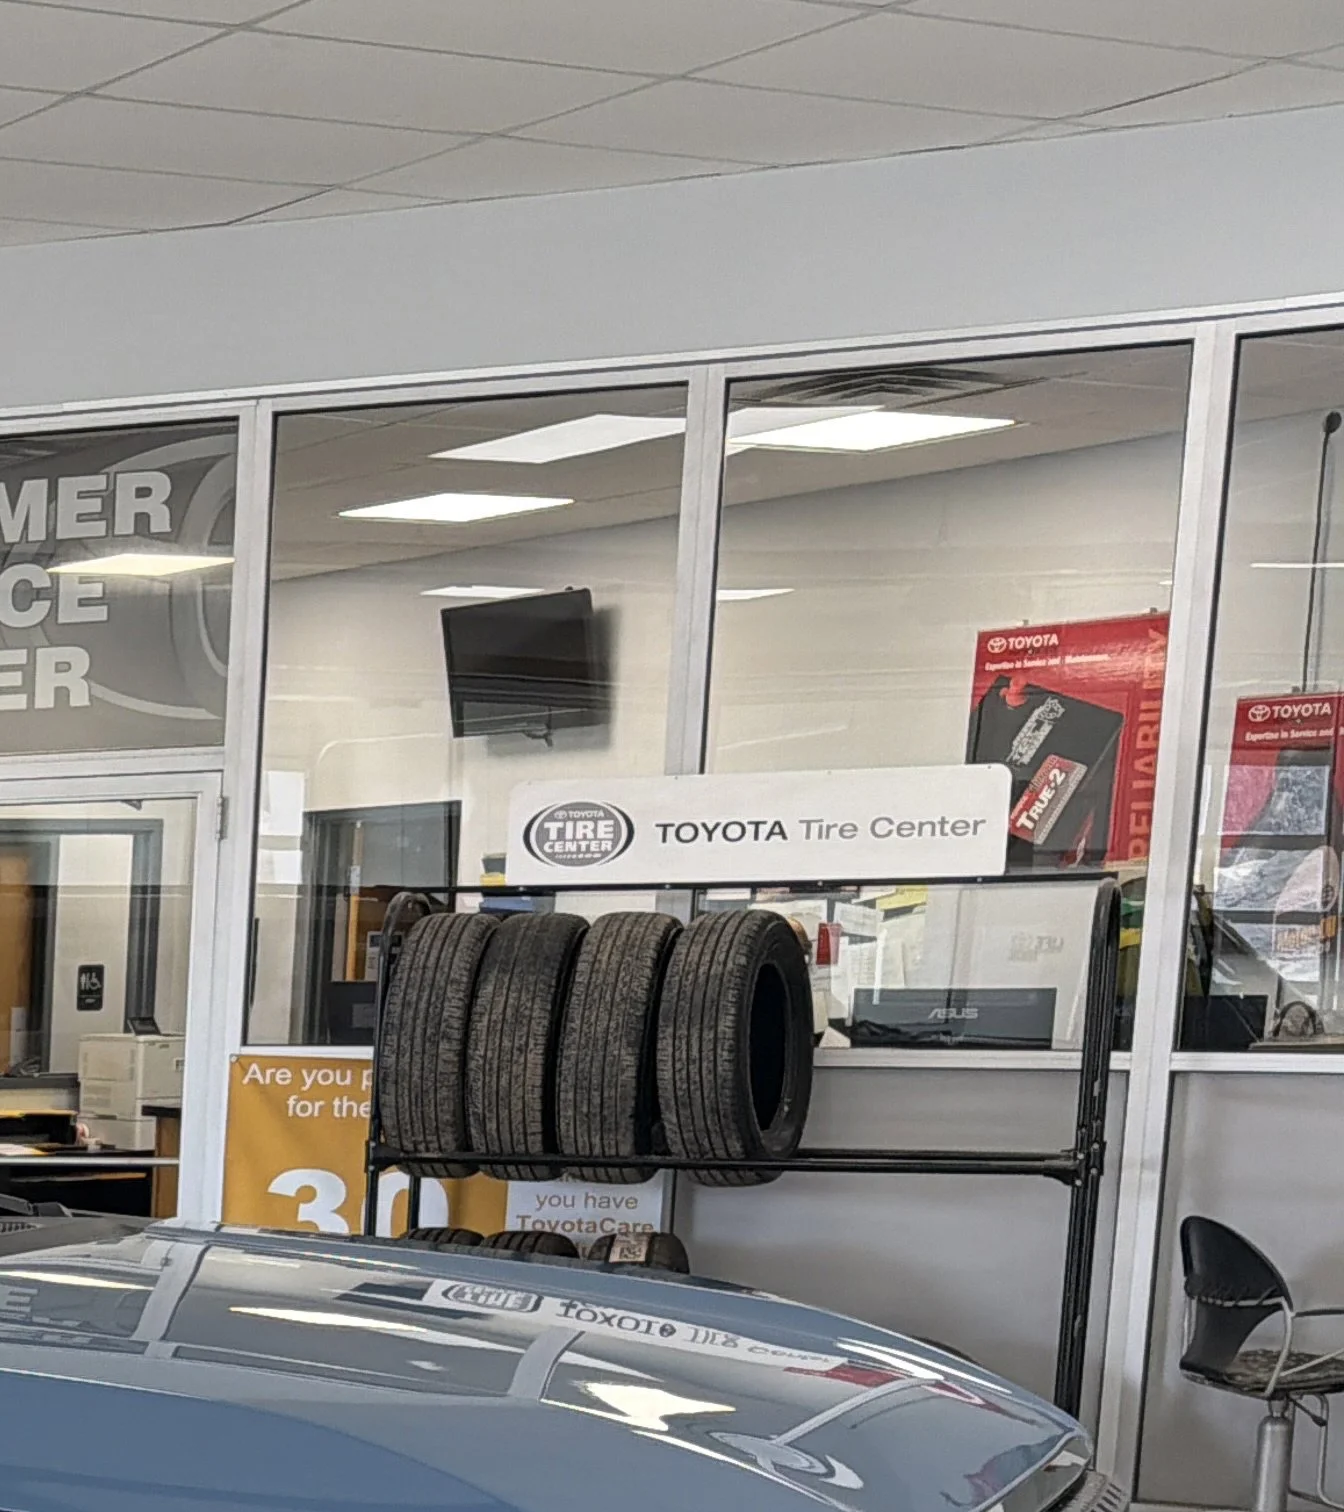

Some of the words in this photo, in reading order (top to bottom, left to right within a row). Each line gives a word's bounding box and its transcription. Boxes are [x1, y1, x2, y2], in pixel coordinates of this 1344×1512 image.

[1007, 633, 1059, 650] TOYOTA
[1272, 702, 1332, 719] TOYOTA
[1245, 731, 1279, 742] Expertise
[1280, 729, 1289, 739] in
[1290, 729, 1317, 739] Service
[1319, 727, 1333, 737] and
[568, 809, 605, 818] TOYOTA
[543, 820, 614, 840] TIRE
[655, 820, 788, 844] TOYOTA
[798, 818, 859, 841] Tire
[869, 815, 987, 839] Center
[543, 840, 612, 853] CENTER
[928, 1007, 979, 1020] ASUS
[242, 1062, 293, 1085] Are
[301, 1067, 352, 1091] you
[287, 1095, 324, 1117] for
[332, 1096, 373, 1118] the
[535, 1194, 575, 1211] you
[584, 1192, 639, 1209] have
[516, 1215, 654, 1235] ToyotaCare
